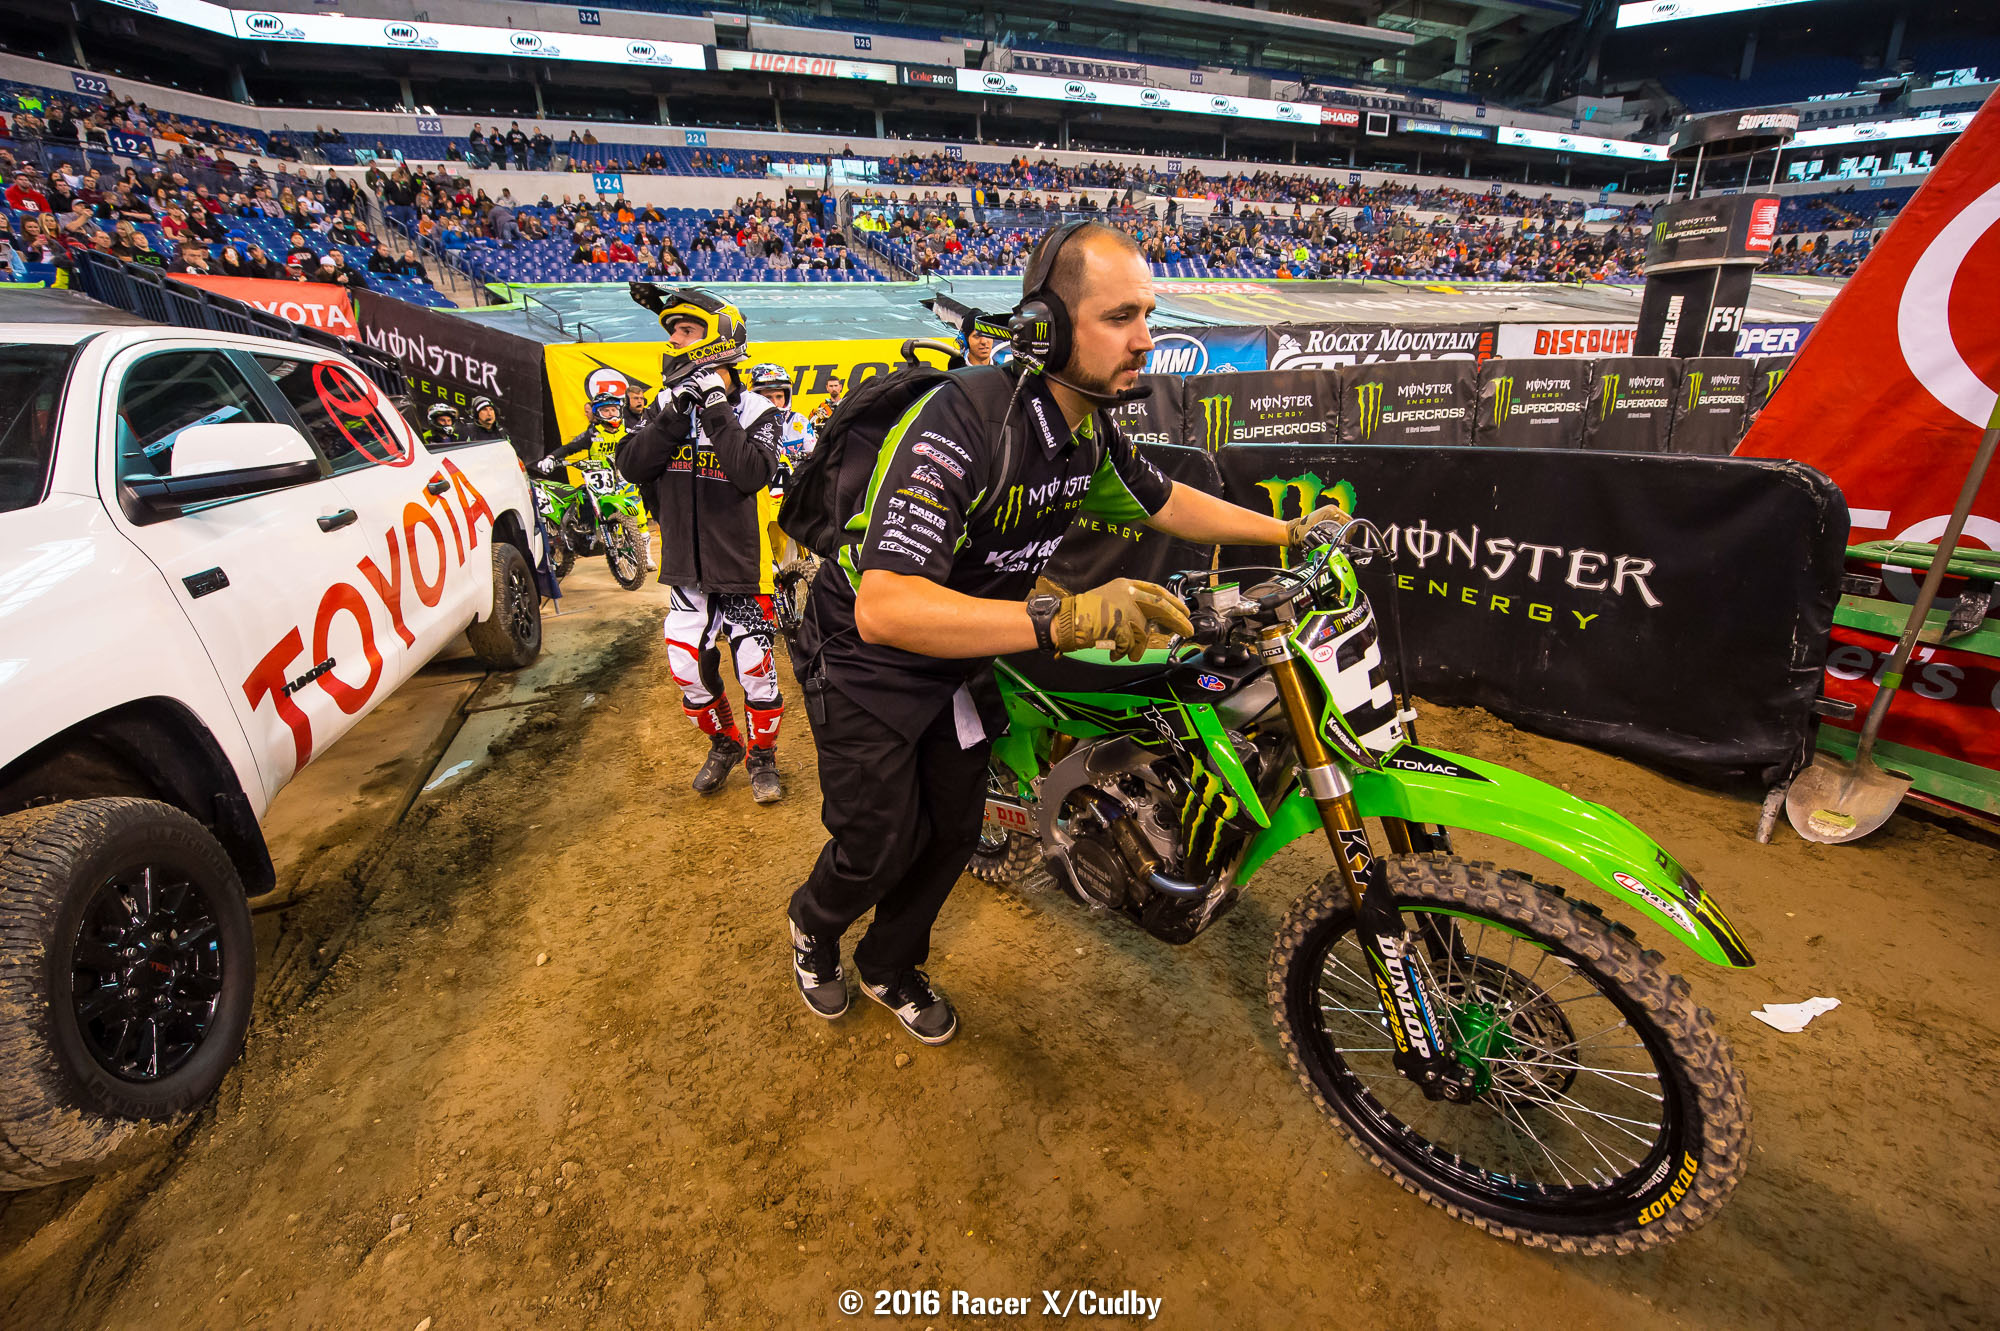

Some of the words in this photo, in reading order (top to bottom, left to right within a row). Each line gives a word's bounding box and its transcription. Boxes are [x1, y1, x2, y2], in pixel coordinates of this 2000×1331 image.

[1656, 4, 1676, 13] MMI
[254, 20, 277, 30] MMI
[580, 12, 599, 23] 324
[392, 28, 413, 38] MMI
[516, 38, 537, 46] MMI
[855, 38, 871, 48] 325
[632, 47, 651, 55] MMI
[750, 54, 807, 74] LUCAS
[810, 59, 838, 77] OIL
[76, 76, 108, 93] 222
[987, 77, 1002, 85] MMI
[1068, 85, 1083, 94] MMI
[1144, 92, 1158, 100] MMI
[1321, 110, 1359, 124] SHARP
[1941, 120, 1960, 128] MMI
[418, 120, 441, 132] 223
[1857, 128, 1874, 136] MMI
[114, 136, 148, 154] 12
[687, 134, 706, 144] 224
[1168, 163, 1182, 171] 227
[595, 177, 622, 192] 124
[1665, 226, 1728, 240] SUPERCROSS
[1854, 229, 1872, 240] 132
[1708, 307, 1744, 332] FS1
[1305, 330, 1374, 353] ROCKY
[1374, 329, 1479, 351] MOUNTAIN
[366, 325, 502, 397] MONSTER
[1150, 347, 1198, 374] MMI
[1526, 378, 1570, 392] MONSTER
[1628, 376, 1665, 388] MONSTER
[1398, 382, 1453, 398] MONSTER
[1250, 394, 1314, 412] MONSTER
[1510, 402, 1581, 415] SUPERCROSS
[1616, 398, 1668, 409] SUPERCROSS
[1260, 410, 1304, 420] ENERGY
[1382, 408, 1466, 424] SUPERCROSS
[1032, 397, 1057, 450] Kawasaki
[1232, 422, 1327, 440] SUPERCROSS
[921, 430, 972, 462] DUNLOP
[910, 472, 945, 490] RENTHAL
[913, 492, 950, 511] CIRCUIT
[910, 502, 947, 526] PARTS
[1071, 517, 1144, 542] NERGY
[1364, 519, 1664, 608] MONSTER
[1398, 574, 1600, 631] ENERGY
[242, 457, 495, 780] TOYOTA
[281, 657, 336, 698] TUNDRA
[1201, 676, 1218, 690] VP
[1326, 716, 1361, 757] Kawasaki
[1393, 758, 1458, 776] TOMAC
[1376, 934, 1431, 1059] DUNLOP
[1638, 1151, 1698, 1226] DUNLOP
